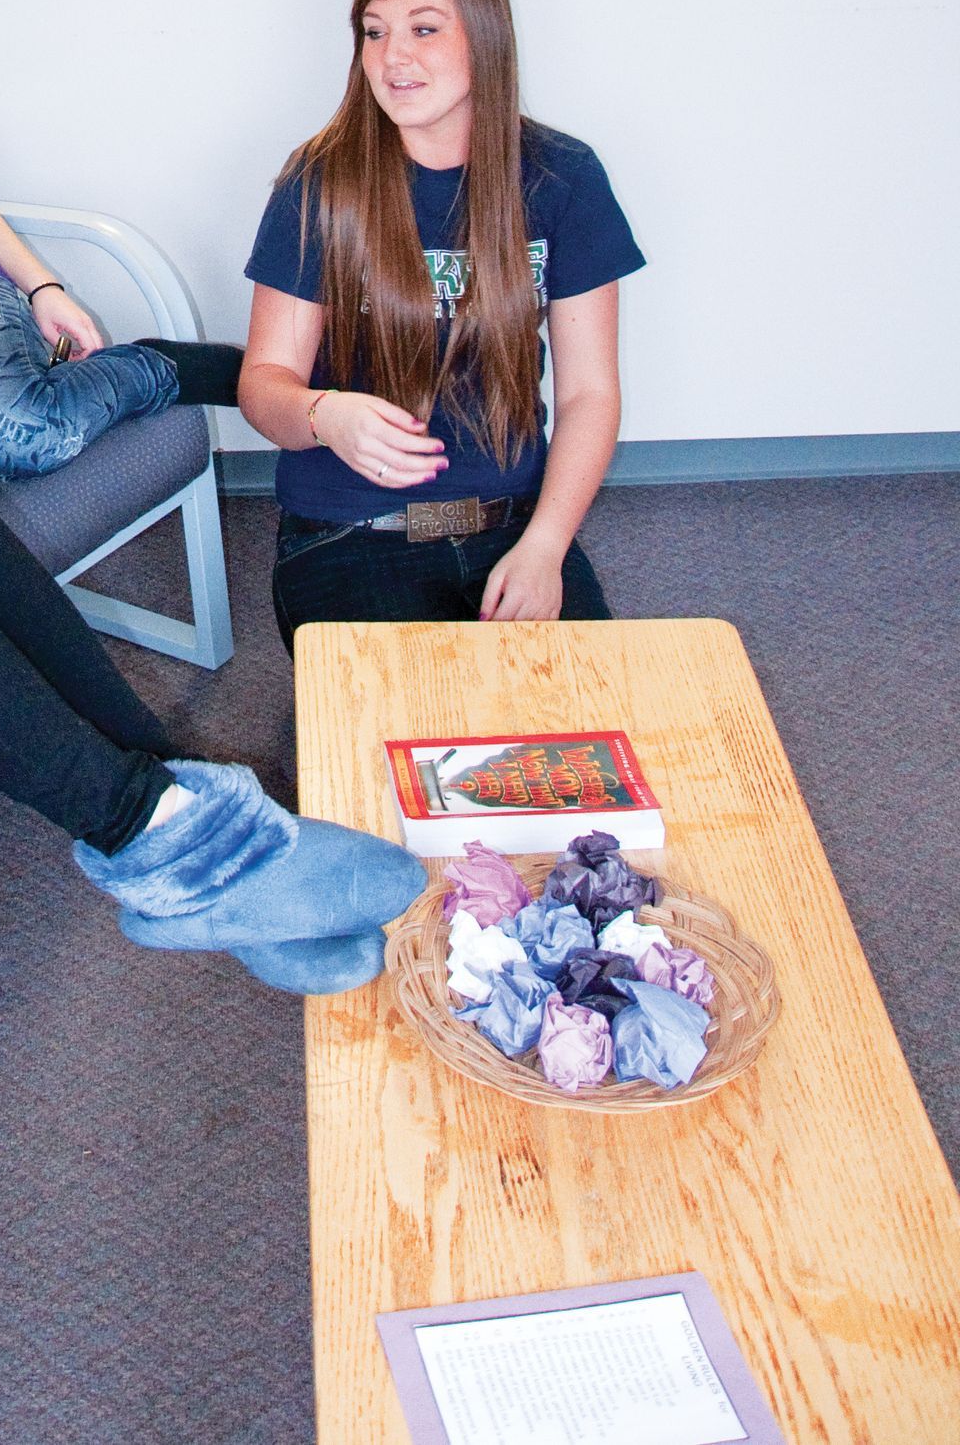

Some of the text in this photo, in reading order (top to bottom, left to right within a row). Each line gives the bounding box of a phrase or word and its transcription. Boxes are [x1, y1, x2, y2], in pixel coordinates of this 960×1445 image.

[411, 518, 476, 533] REVOLVERS
[440, 501, 467, 520] COLT
[614, 739, 630, 769] SURVIVING
[470, 770, 502, 799] HER
[500, 771, 530, 805] NEED
[547, 763, 582, 797] MOM
[681, 1320, 704, 1363] GOLDEN
[701, 1363, 722, 1395] RULES
[681, 1355, 703, 1387] LIVING
